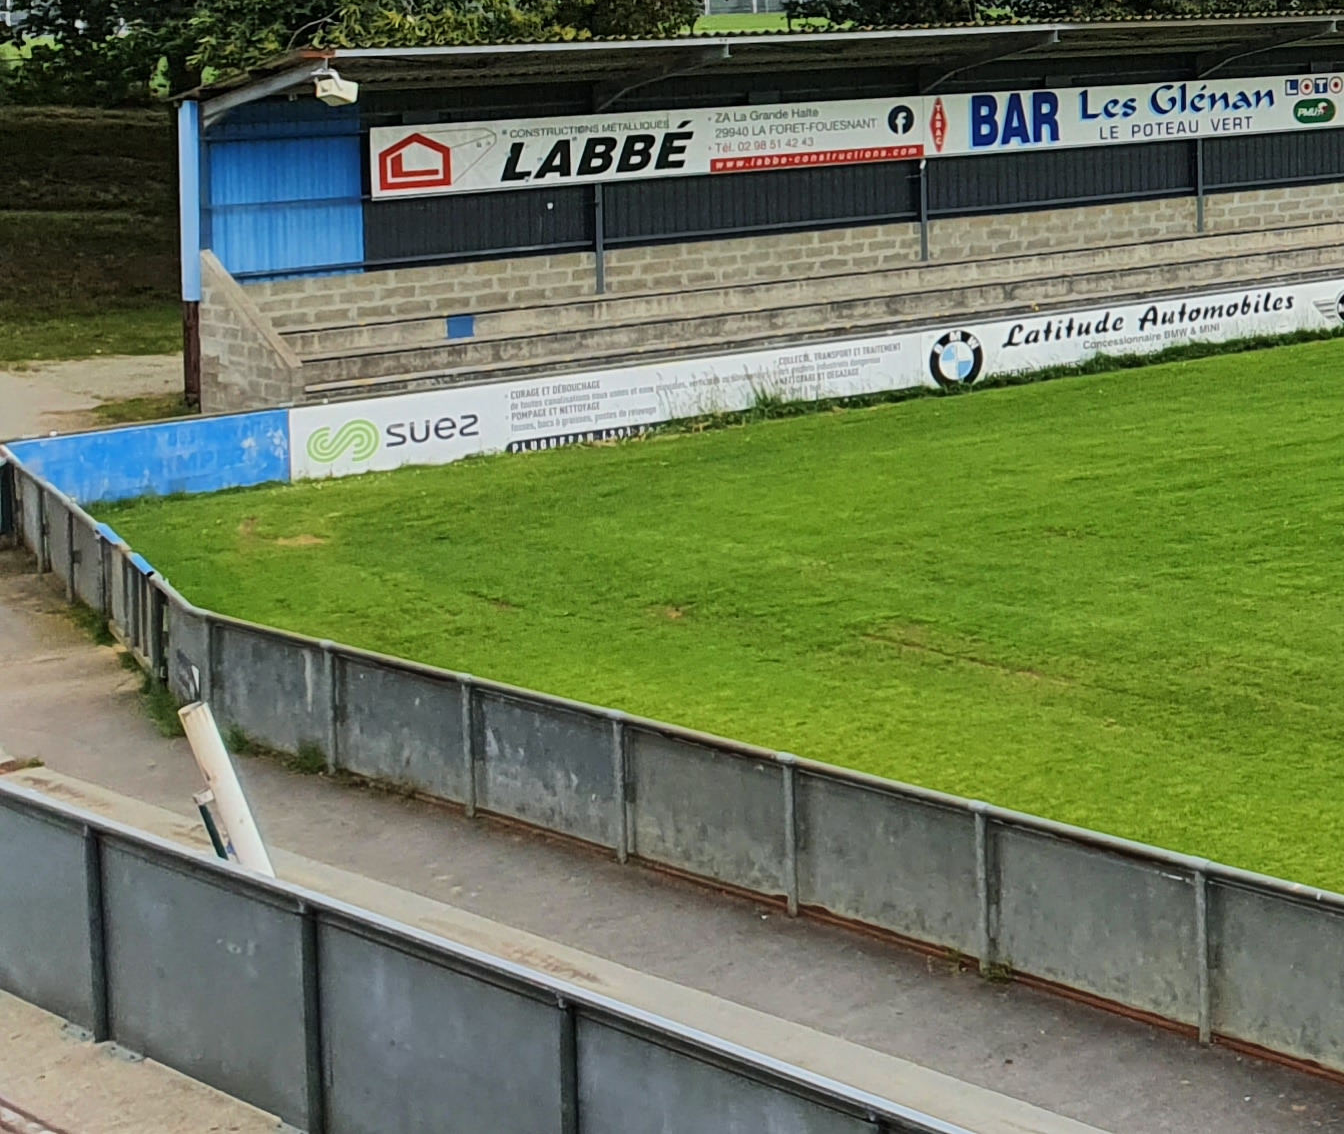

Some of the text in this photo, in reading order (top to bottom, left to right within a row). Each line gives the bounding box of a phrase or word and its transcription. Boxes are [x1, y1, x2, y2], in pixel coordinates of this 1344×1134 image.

[1285, 76, 1344, 96] LOTO
[1080, 83, 1275, 120] Les Glénan
[715, 113, 731, 123] ZA
[734, 112, 747, 122] La
[750, 110, 788, 121] Grande
[934, 104, 943, 146] TABAC
[972, 91, 1060, 147] BAR
[510, 124, 599, 139] CONSTRUCTIONS
[715, 128, 749, 138] 29940
[752, 125, 767, 136] LA
[1100, 116, 1254, 140] LE POTEAU VERT
[501, 120, 694, 182] LABBÉ
[715, 137, 814, 154] Tél. 02 98 51 42 43
[715, 147, 918, 169] www.labbe-constructions.com
[1002, 292, 1295, 348] Latitude Automobiles
[934, 330, 980, 354] BMW
[1083, 323, 1221, 350] Concessionnaire BMW & MINI
[814, 349, 852, 362] TRANSPORT
[853, 347, 861, 357] ET
[863, 342, 901, 356] TRAITEMENT
[511, 380, 600, 399] CURAGE ET DÉBOUCHAGE
[511, 402, 518, 411] de
[521, 398, 542, 409] toutes
[544, 392, 590, 406] canalisations
[511, 401, 600, 421] POMPAGE ET NETTOYAGE
[386, 414, 479, 448] suez
